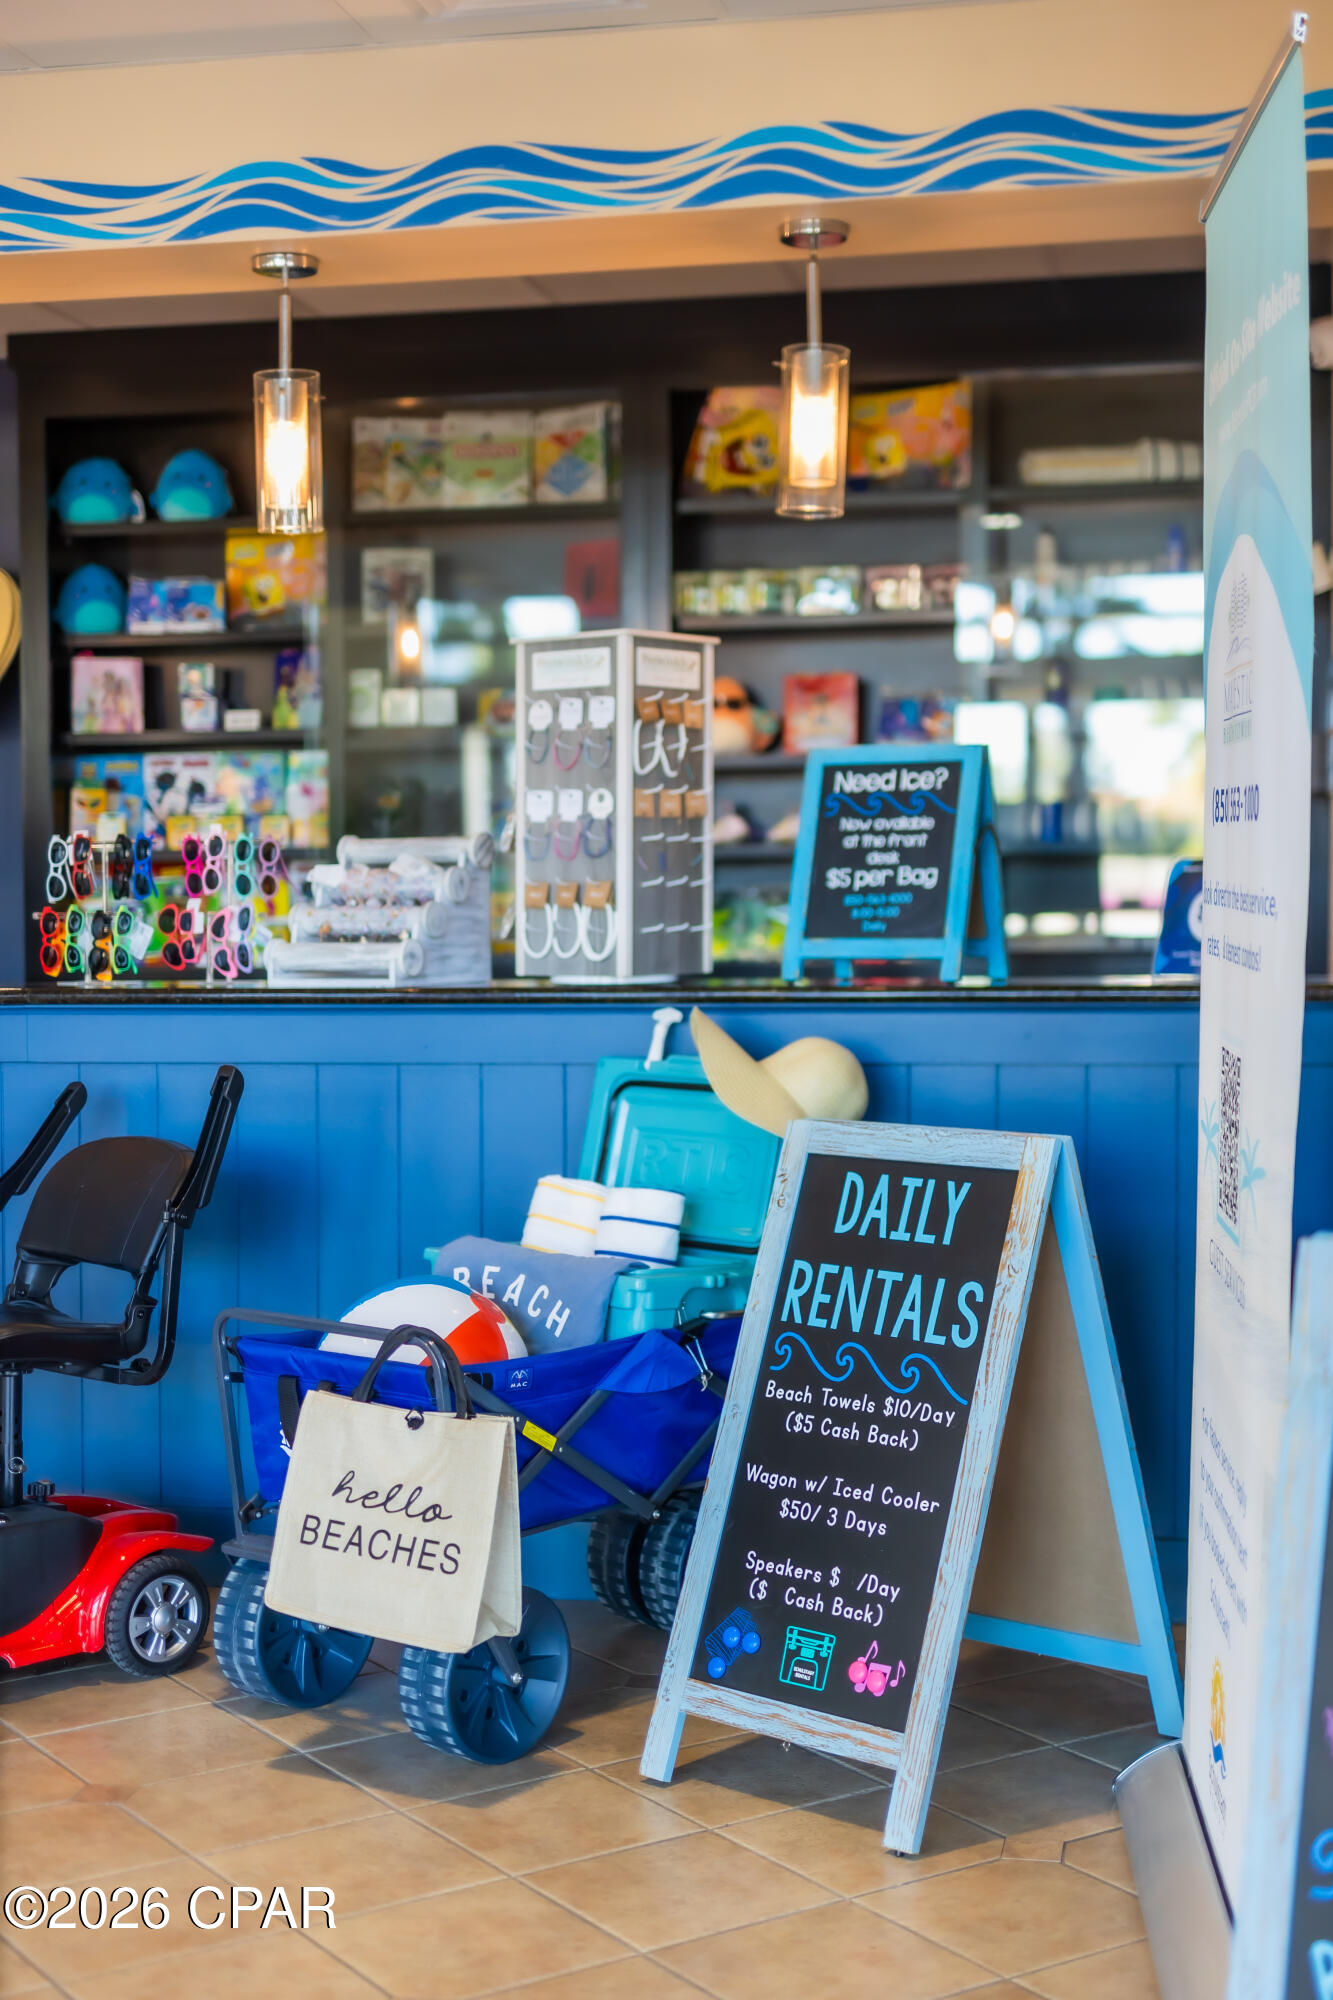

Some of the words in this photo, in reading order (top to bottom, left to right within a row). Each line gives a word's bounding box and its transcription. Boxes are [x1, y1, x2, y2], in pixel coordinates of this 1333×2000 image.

[834, 768, 897, 794] Need
[899, 766, 949, 791] Ice?
[839, 816, 872, 832] Now
[842, 833, 860, 848] at
[861, 833, 886, 848] the
[887, 832, 928, 848] front
[826, 867, 852, 890] $5
[852, 868, 894, 892] per
[896, 865, 939, 890] Bag
[834, 1171, 972, 1246] DAILY
[453, 1265, 571, 1338] BEACH
[780, 1259, 984, 1349] RENTALS
[765, 1380, 812, 1404] Beach
[822, 1388, 876, 1413] Towels
[883, 1396, 955, 1427] $10/Day
[785, 1410, 814, 1435] ($5
[821, 1418, 860, 1441] Cash
[868, 1425, 919, 1451] Back)
[331, 1470, 453, 1523] hello
[746, 1462, 797, 1490] Wagon
[805, 1475, 828, 1493] w/
[832, 1478, 874, 1502] Iced
[882, 1486, 940, 1513] Cooler
[779, 1498, 822, 1524] $50/
[827, 1507, 838, 1527] 3
[845, 1511, 888, 1538] Days
[299, 1514, 461, 1575] BEACHES
[746, 1551, 822, 1584] Speakers
[829, 1566, 841, 1588] $
[857, 1573, 901, 1603] /Day
[749, 1577, 767, 1601] ($
[784, 1586, 824, 1613] Cash
[832, 1602, 883, 1627] Back)
